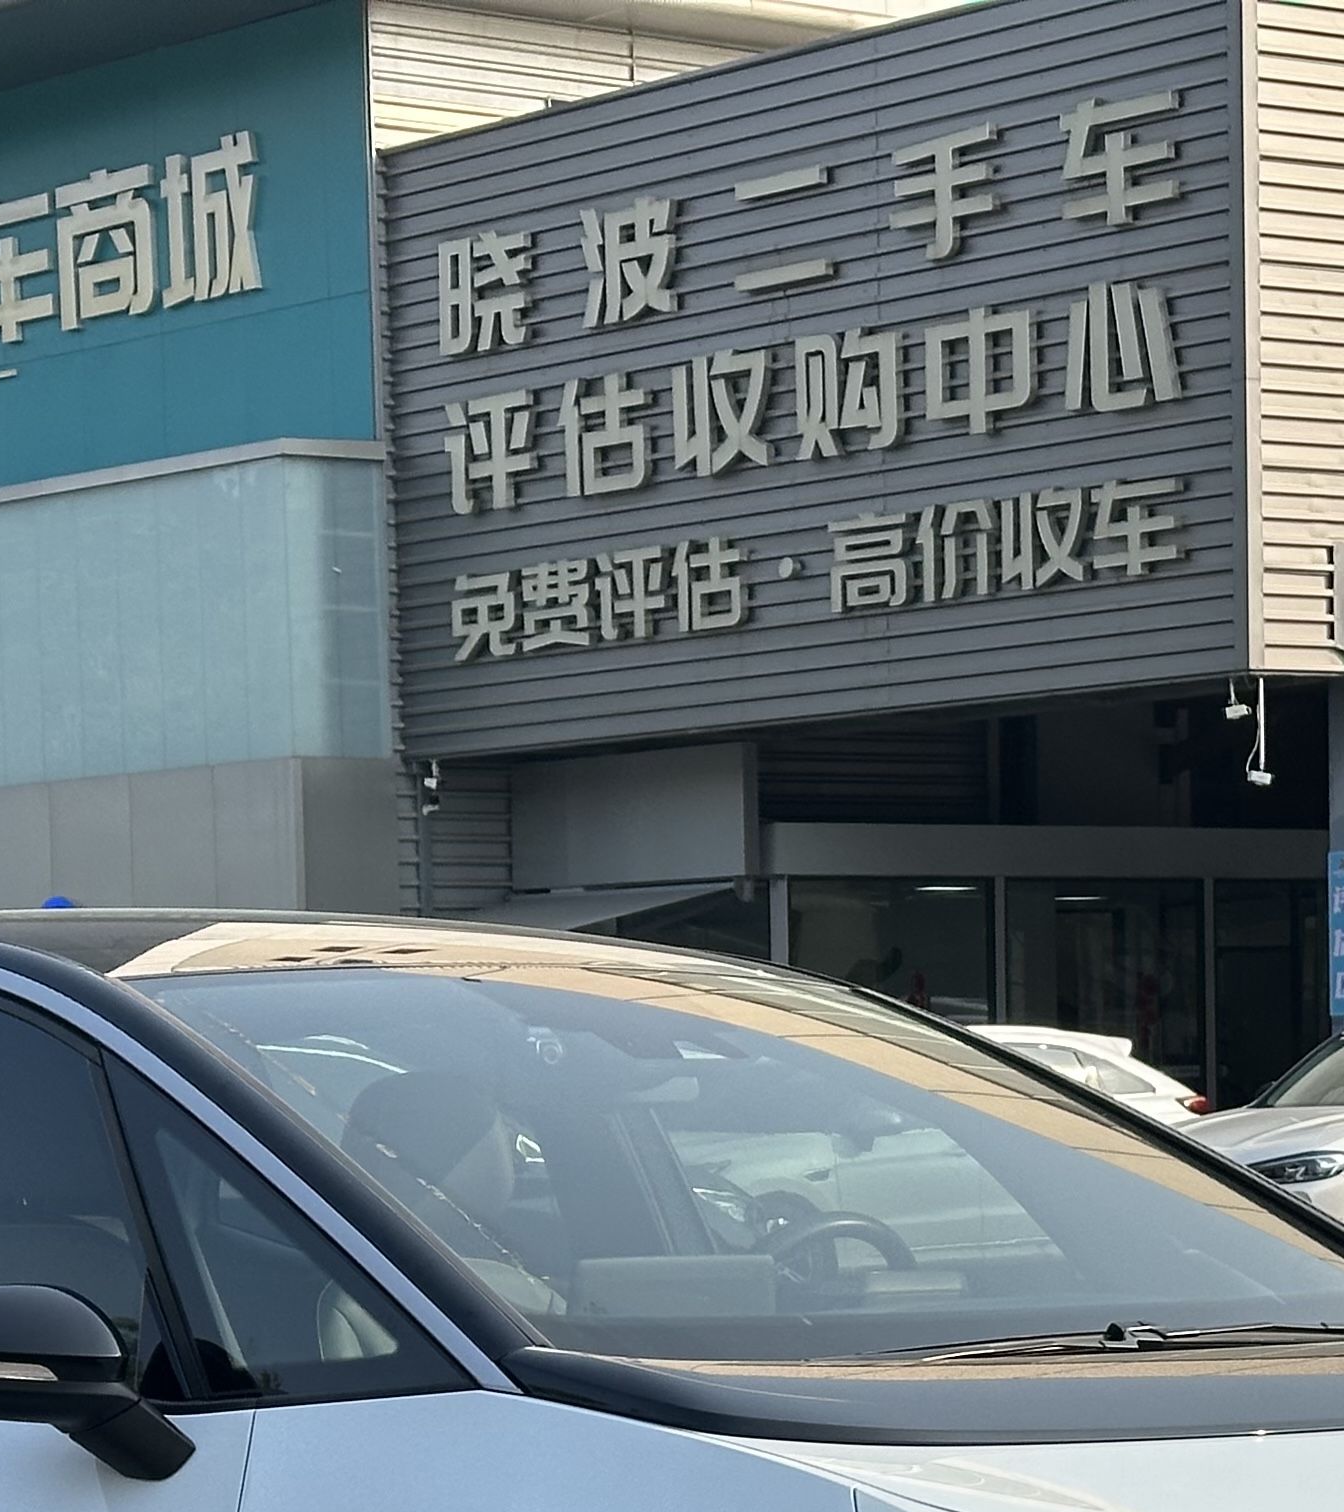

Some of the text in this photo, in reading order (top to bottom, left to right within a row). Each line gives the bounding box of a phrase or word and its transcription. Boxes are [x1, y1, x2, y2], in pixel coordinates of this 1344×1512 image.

[439, 89, 1186, 357] 晓波二手车
[444, 282, 1184, 516] 评估收购中心
